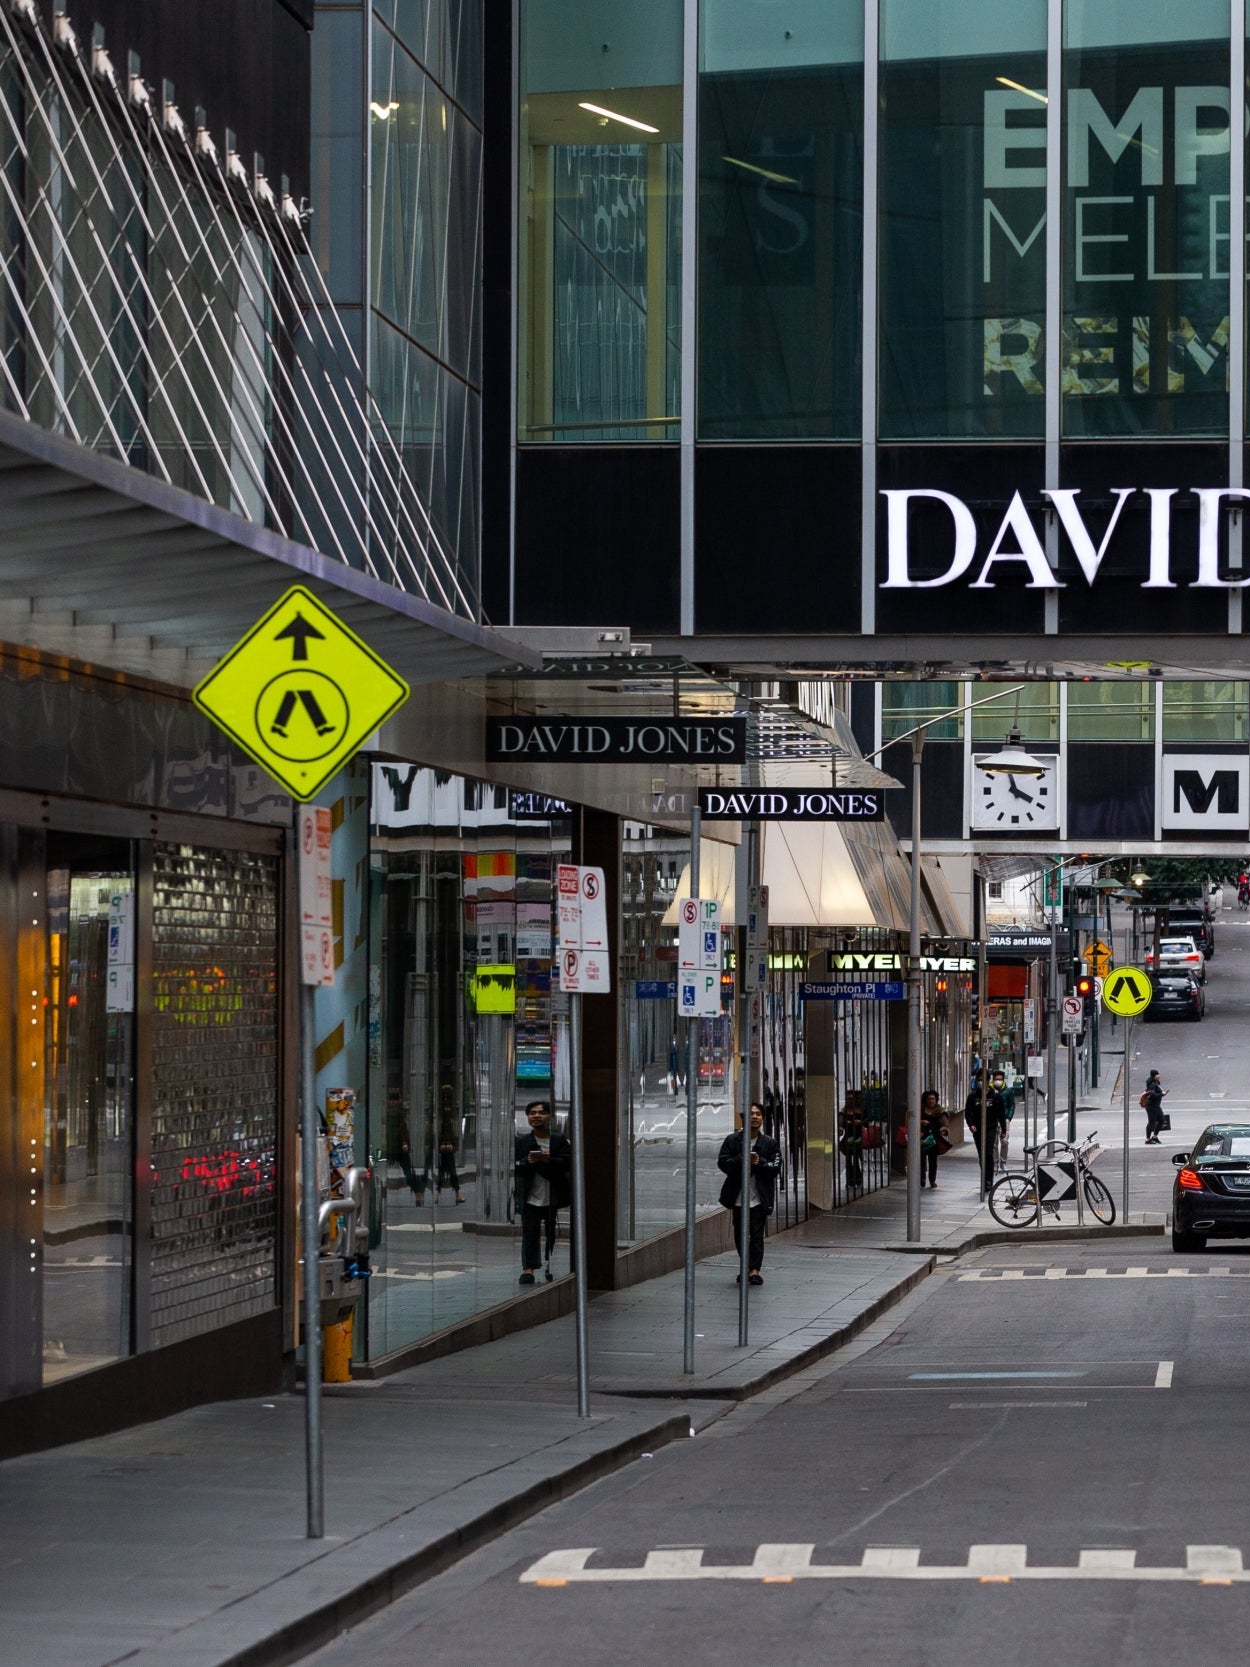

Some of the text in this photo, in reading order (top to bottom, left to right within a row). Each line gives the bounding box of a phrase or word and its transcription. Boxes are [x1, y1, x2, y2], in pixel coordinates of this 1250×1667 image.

[498, 725, 736, 755] DAVID JONES
[705, 794, 788, 815] DAVID
[793, 794, 878, 817] JONES
[705, 902, 718, 919] 1P
[1013, 937, 1027, 946] and
[1029, 937, 1053, 946] IMAGIN
[804, 983, 876, 996] Staughton Pl
